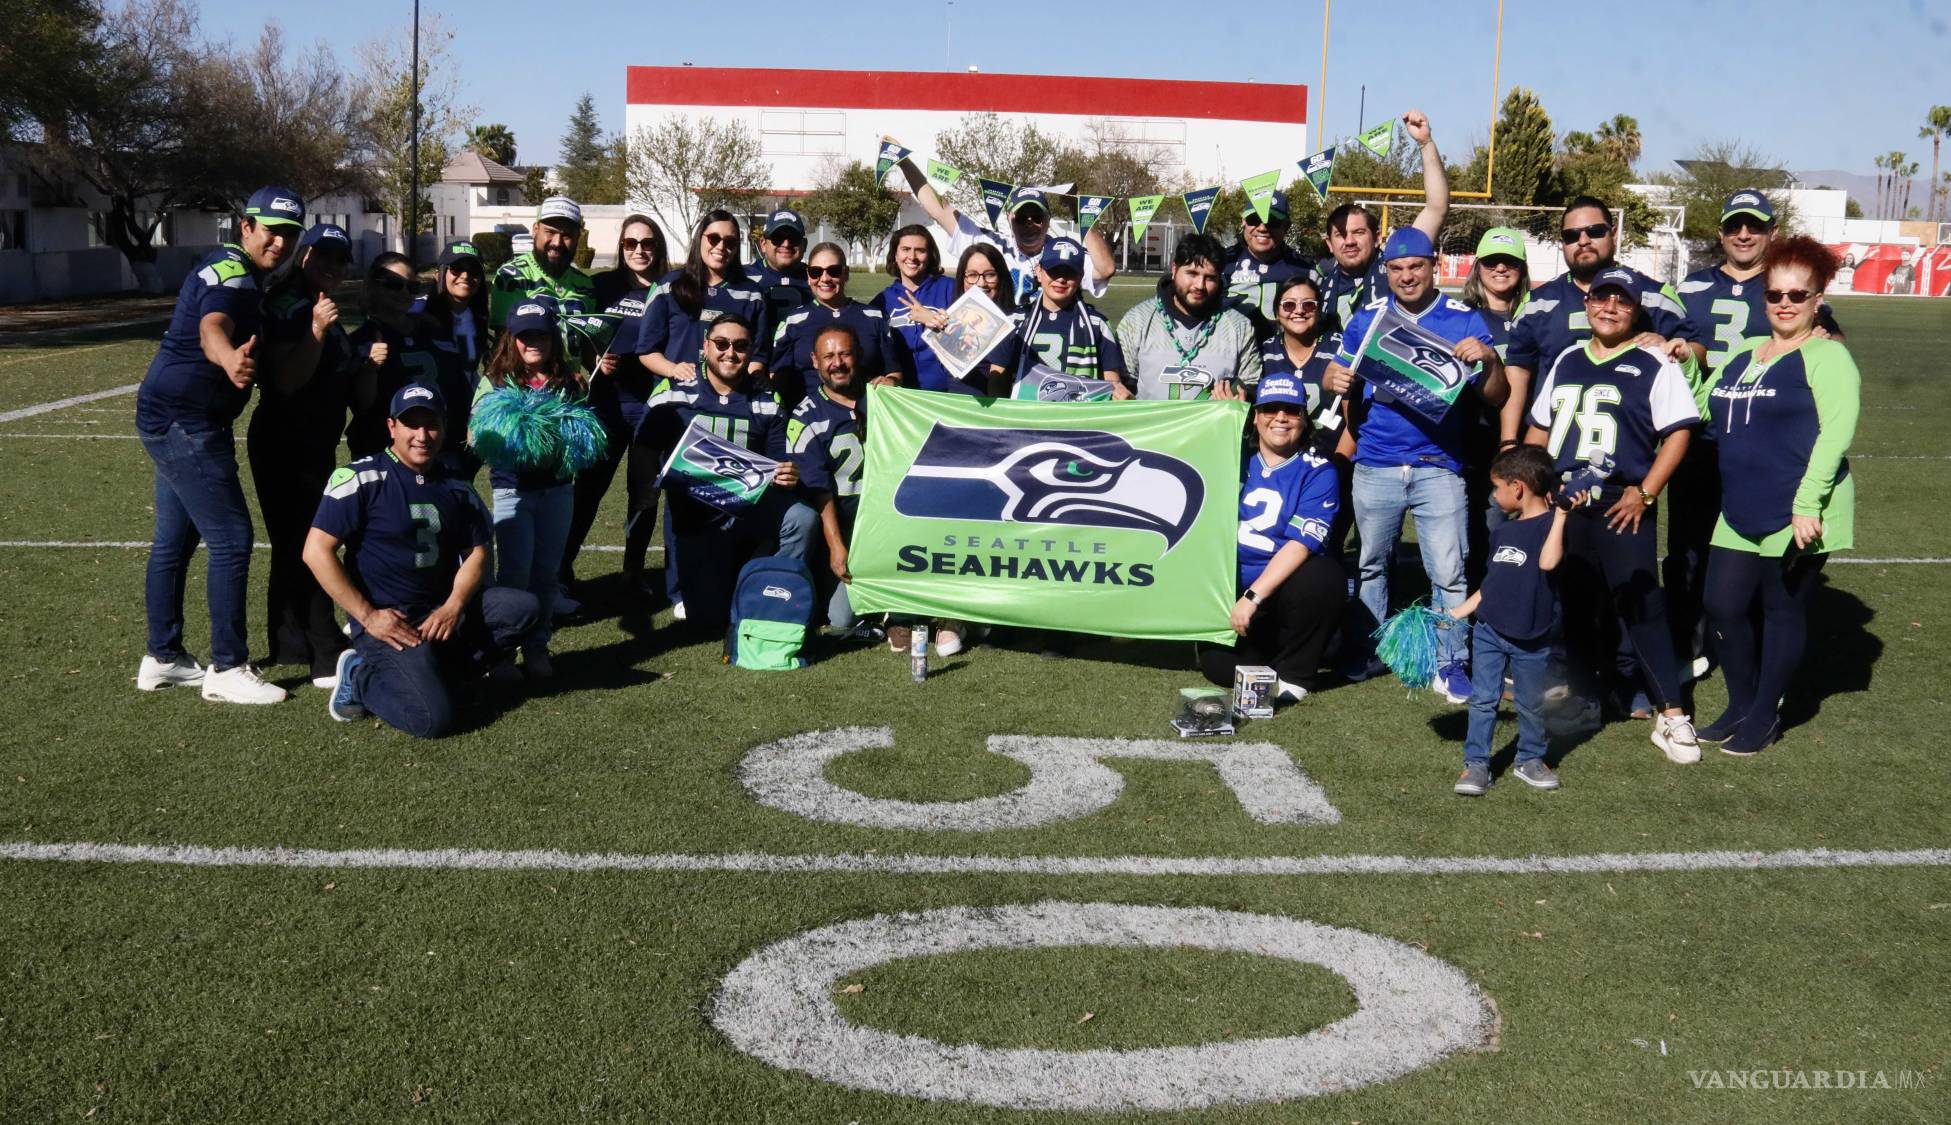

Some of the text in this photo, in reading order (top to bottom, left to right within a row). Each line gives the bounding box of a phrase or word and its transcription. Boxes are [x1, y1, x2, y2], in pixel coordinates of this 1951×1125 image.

[1706, 299, 1750, 368] 3
[1594, 389, 1611, 397] SINCE
[1711, 387, 1777, 399] SEAHAWKS
[1547, 384, 1622, 460] 76
[830, 433, 866, 496] 2
[409, 504, 441, 568] 3
[944, 535, 1106, 554] SEATTLE
[896, 545, 1155, 587] SEAHAWKS
